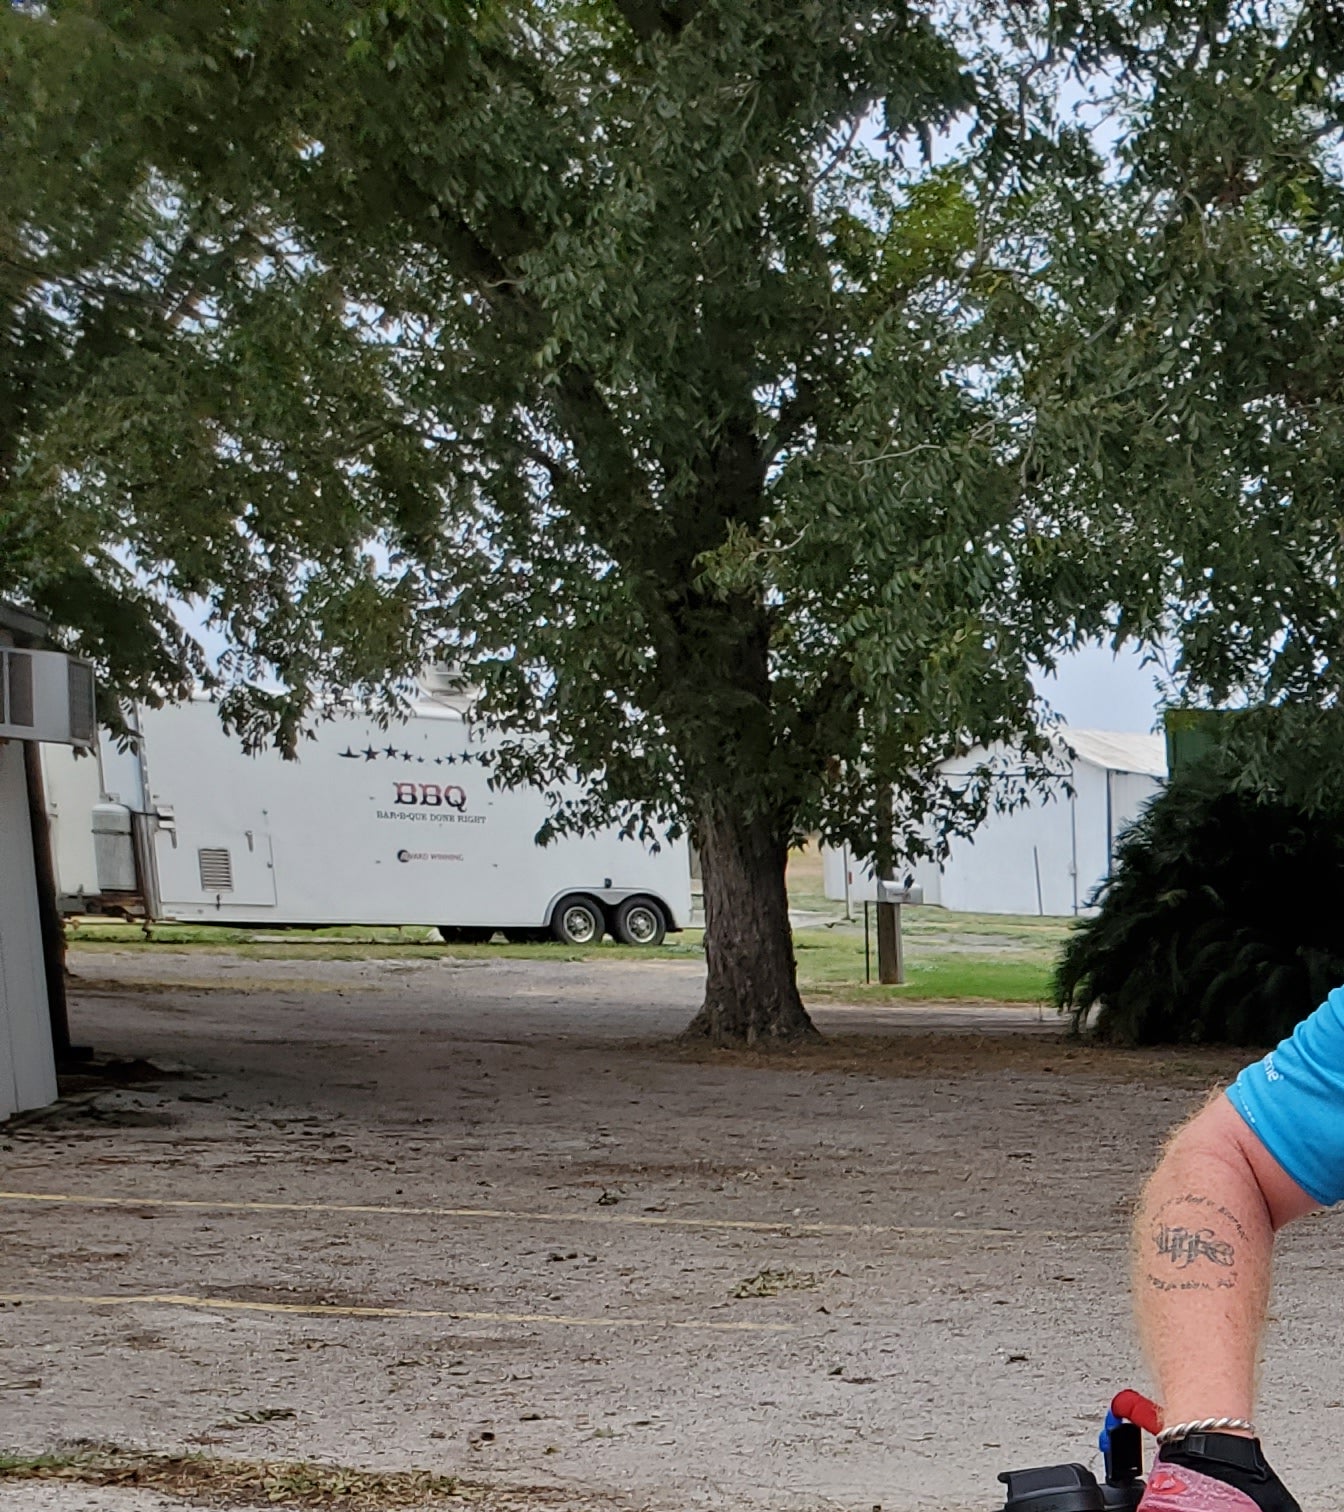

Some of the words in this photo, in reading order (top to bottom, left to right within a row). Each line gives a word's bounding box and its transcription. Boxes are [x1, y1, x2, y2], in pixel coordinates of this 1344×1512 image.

[393, 782, 467, 812] BBQ
[430, 814, 455, 822] DONE
[457, 815, 487, 824] RIGHT
